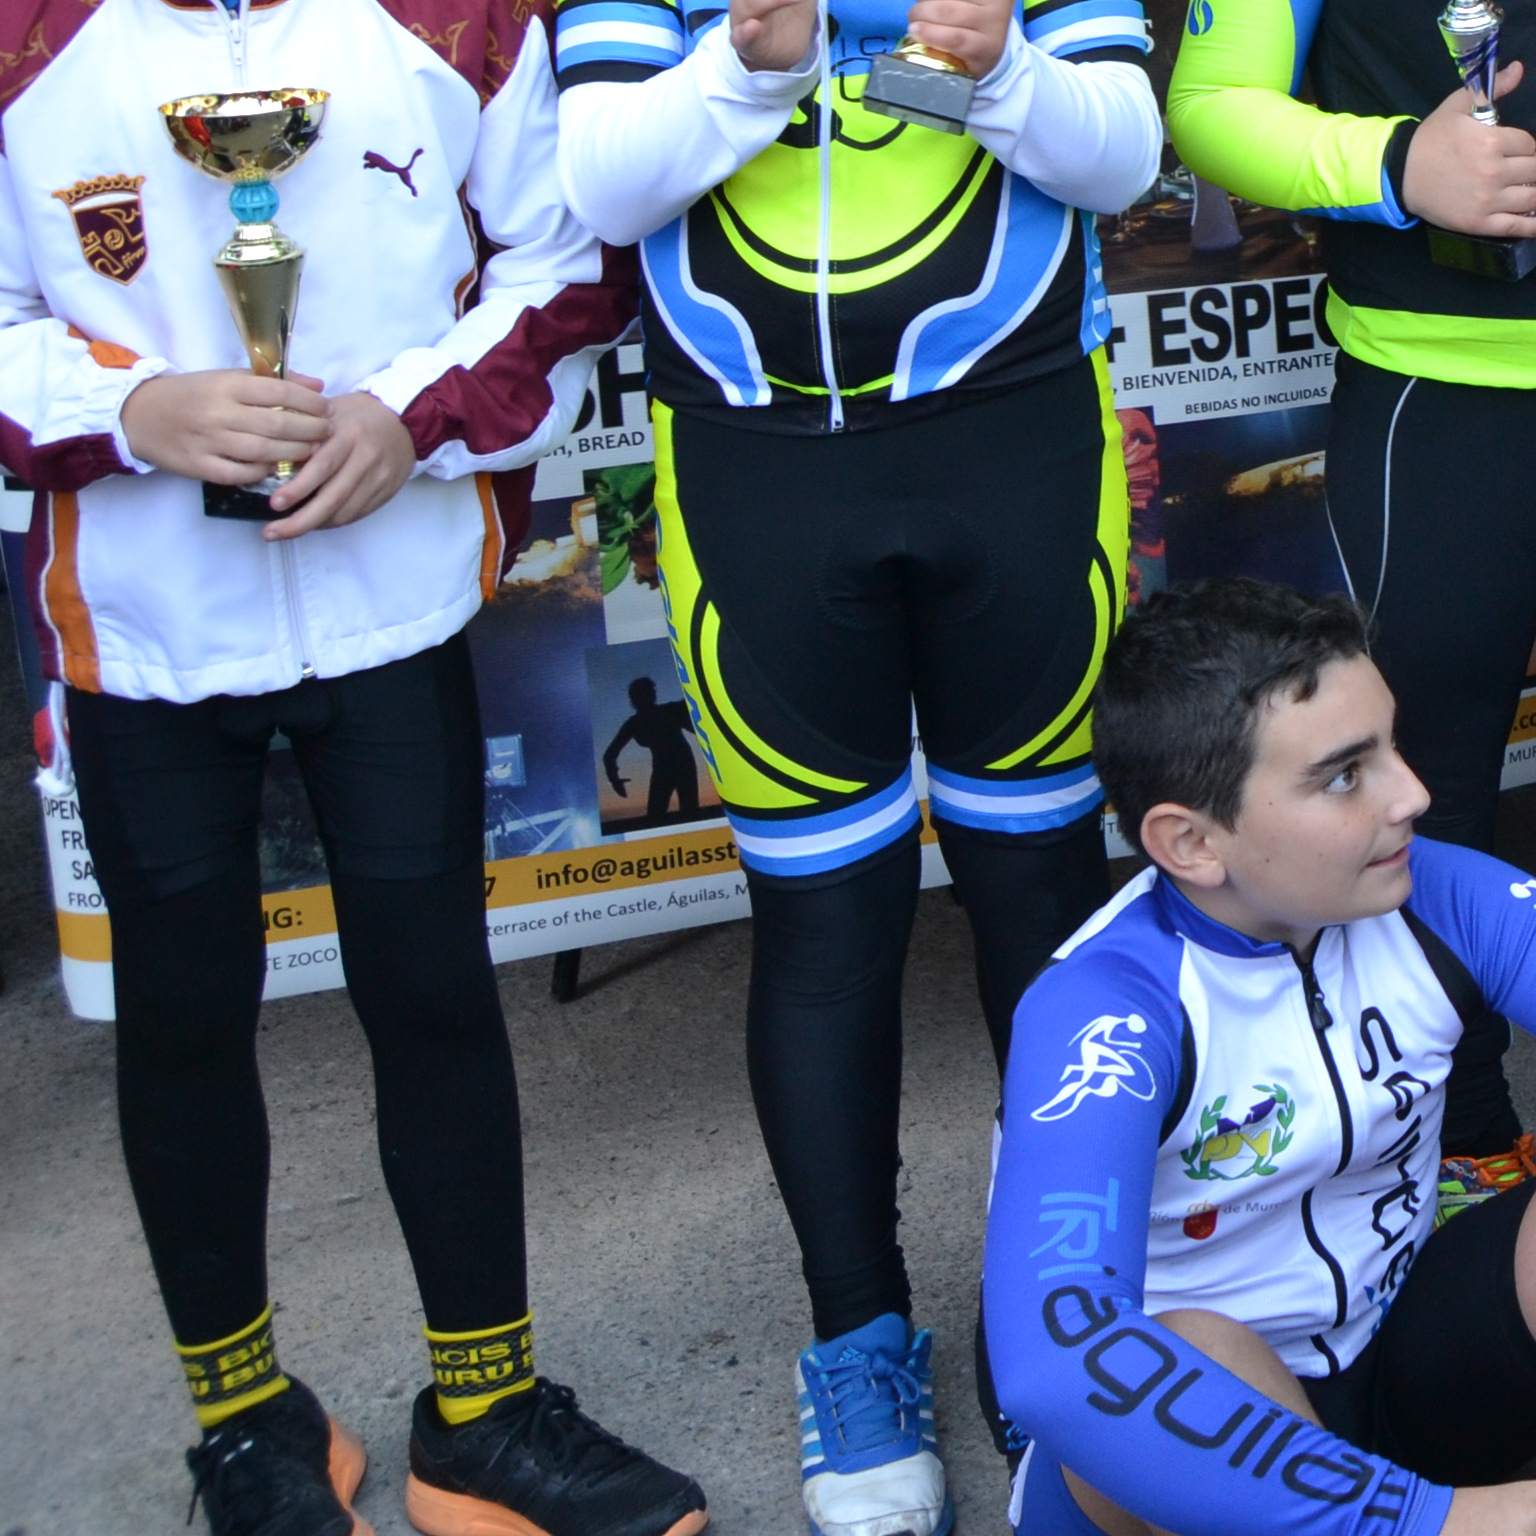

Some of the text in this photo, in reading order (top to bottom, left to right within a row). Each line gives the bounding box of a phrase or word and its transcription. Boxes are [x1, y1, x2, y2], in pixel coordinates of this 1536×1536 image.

[1123, 365, 1239, 392] BIENVENIDA,
[1185, 386, 1328, 415] BEBIDAS NO INCLUIDAS
[578, 431, 645, 453] BREAD
[68, 892, 108, 909] FRO
[288, 947, 338, 969] ZOCO
[552, 913, 569, 927] of
[574, 907, 602, 924] the
[606, 897, 662, 918] Castle,
[666, 888, 731, 909] Águilas,
[1222, 1200, 1242, 1214] de
